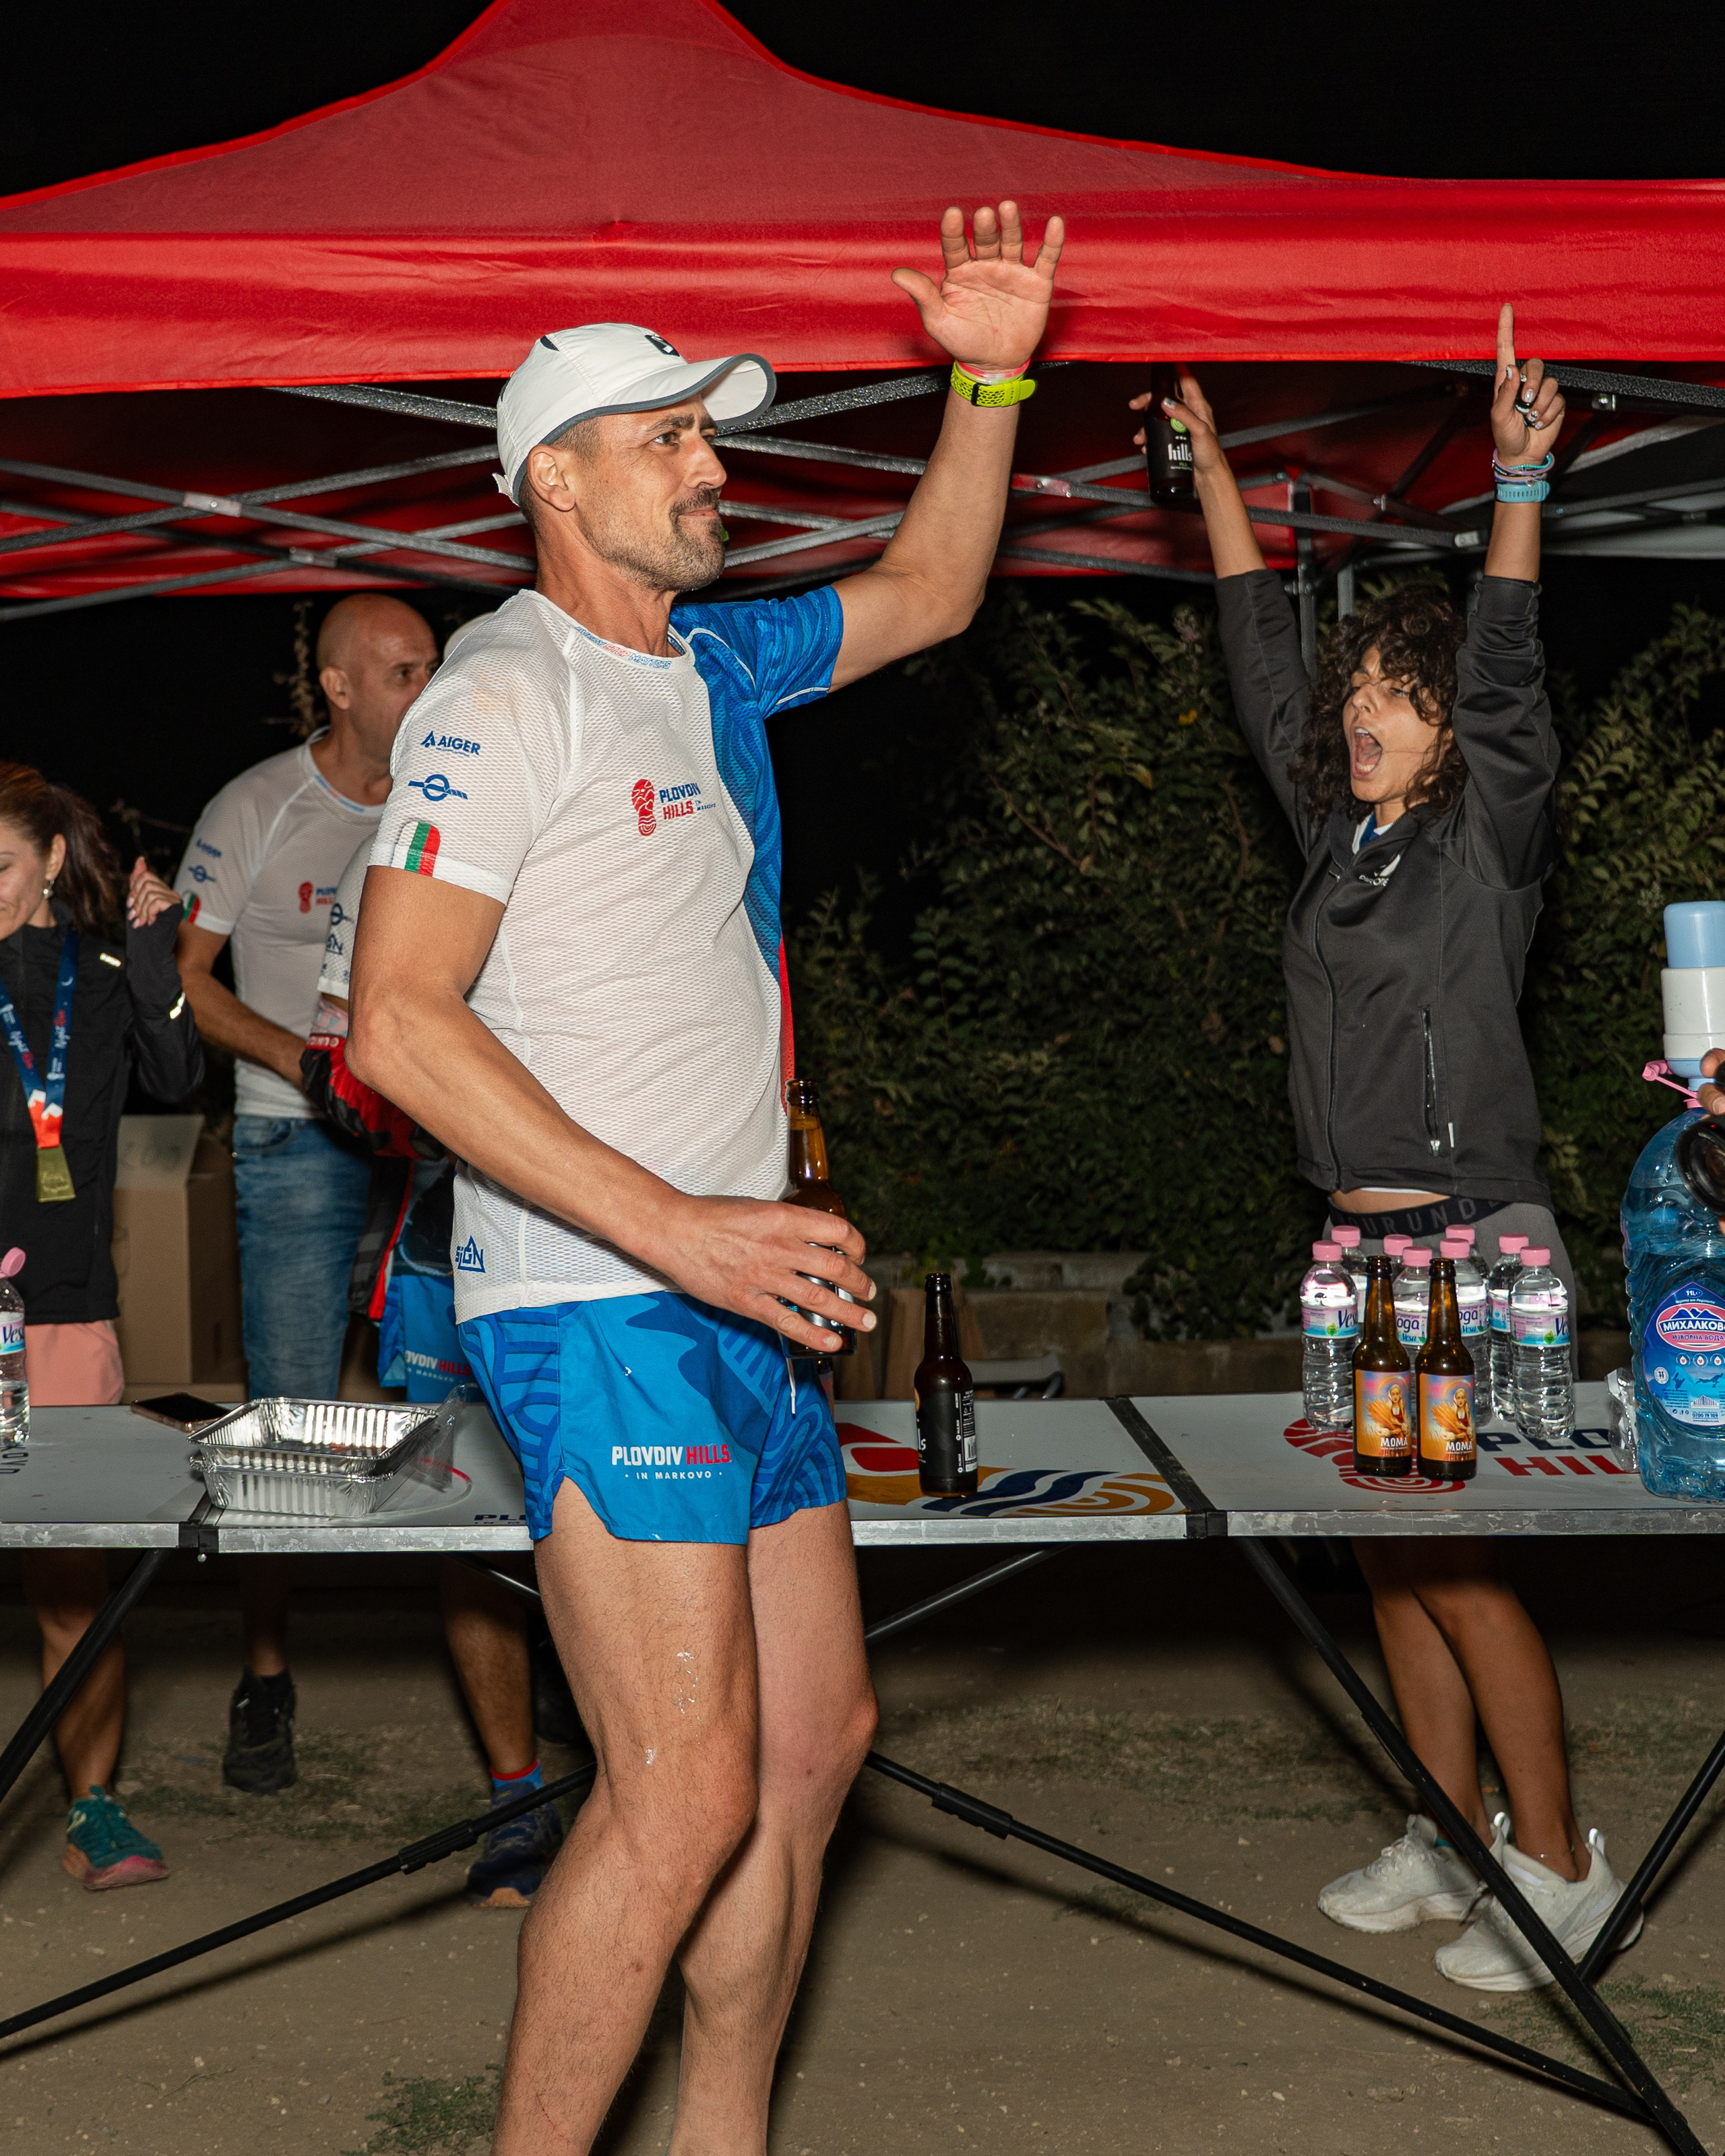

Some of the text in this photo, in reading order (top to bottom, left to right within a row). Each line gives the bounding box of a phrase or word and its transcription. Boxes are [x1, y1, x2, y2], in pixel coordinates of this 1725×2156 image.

[1168, 443, 1192, 462] hills
[602, 643, 631, 658] STEP
[628, 653, 672, 669] MATTERS
[437, 735, 480, 755] AIGER
[662, 800, 694, 820] HILLS
[1338, 1308, 1359, 1329] Ves
[1396, 1318, 1420, 1333] oga
[1662, 1320, 1725, 1332] МИХАЛКОВ
[3, 1323, 25, 1344] Ves
[1402, 1333, 1417, 1342] Vesa
[1462, 1325, 1476, 1333] Vesa
[438, 1360, 471, 1376] HILLS
[1381, 1437, 1408, 1447] MOMA
[1445, 1441, 1474, 1451] MOMA
[612, 1444, 731, 1466] PLOVDIV HILLS
[1493, 1455, 1641, 1476] HIL
[636, 1471, 712, 1480] IN MARKOVO
